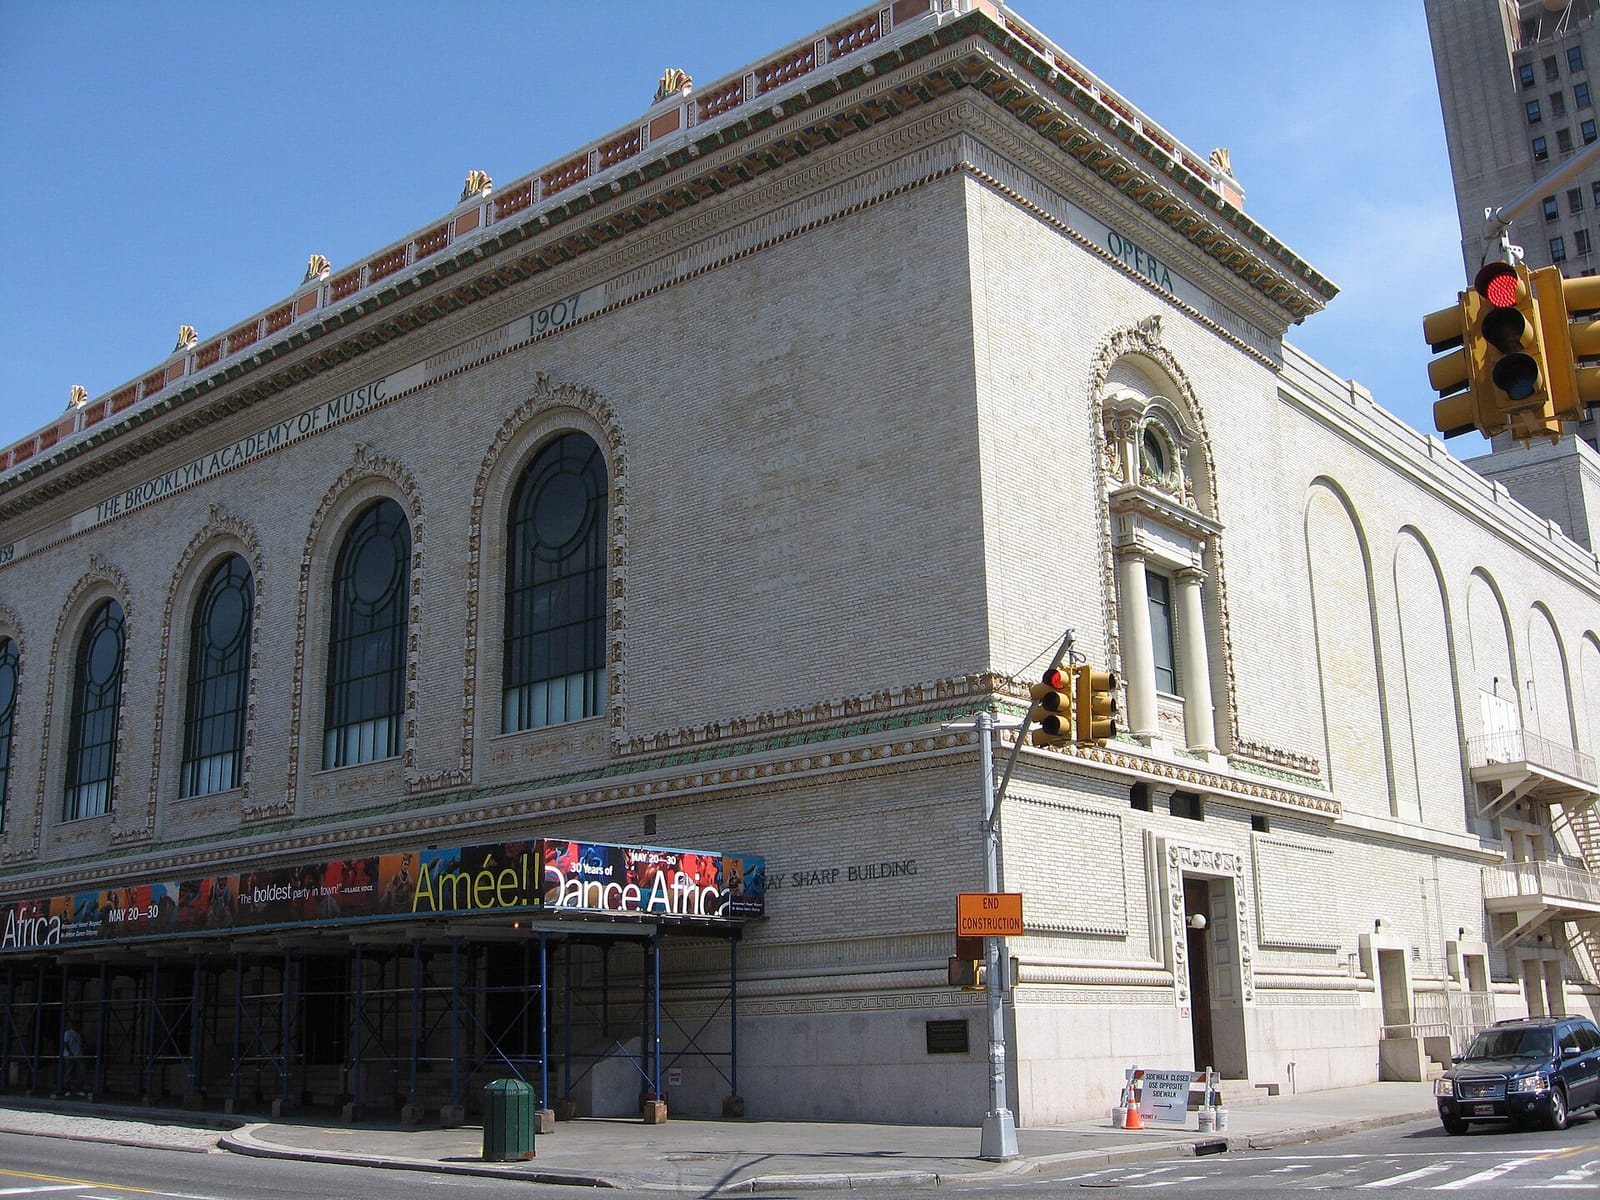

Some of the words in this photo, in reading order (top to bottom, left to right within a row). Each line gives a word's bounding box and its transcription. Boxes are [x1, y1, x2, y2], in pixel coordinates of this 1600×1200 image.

[1107, 231, 1174, 293] OPERA
[529, 294, 581, 337] 1907
[95, 495, 121, 521] THE
[125, 459, 203, 510] BROOKLYN
[208, 419, 295, 474] ACADEMY
[297, 407, 321, 434] OF
[326, 379, 386, 423] MUSIC
[0, 543, 15, 564] 59
[631, 851, 647, 862] MAY
[570, 862, 582, 873] 30
[583, 862, 604, 875] Years
[604, 865, 614, 876] of
[765, 872, 786, 889] AY
[792, 868, 840, 887] SHARP
[848, 859, 917, 882] BUILDING
[253, 882, 292, 903] boldest
[292, 887, 311, 900] party
[311, 885, 319, 897] in
[412, 852, 540, 912] Amée!!
[545, 865, 641, 911] Dance
[646, 870, 730, 915] Africa
[983, 897, 999, 909] END
[109, 909, 126, 923] MAY
[962, 917, 1020, 930] CONSTRUCTION
[1, 906, 61, 949] Africa
[1148, 1081, 1158, 1089] USE
[1160, 1082, 1183, 1090] OPPOSITE
[1170, 1074, 1190, 1082] CLOSED
[1152, 1090, 1177, 1098] SIDEWALK
